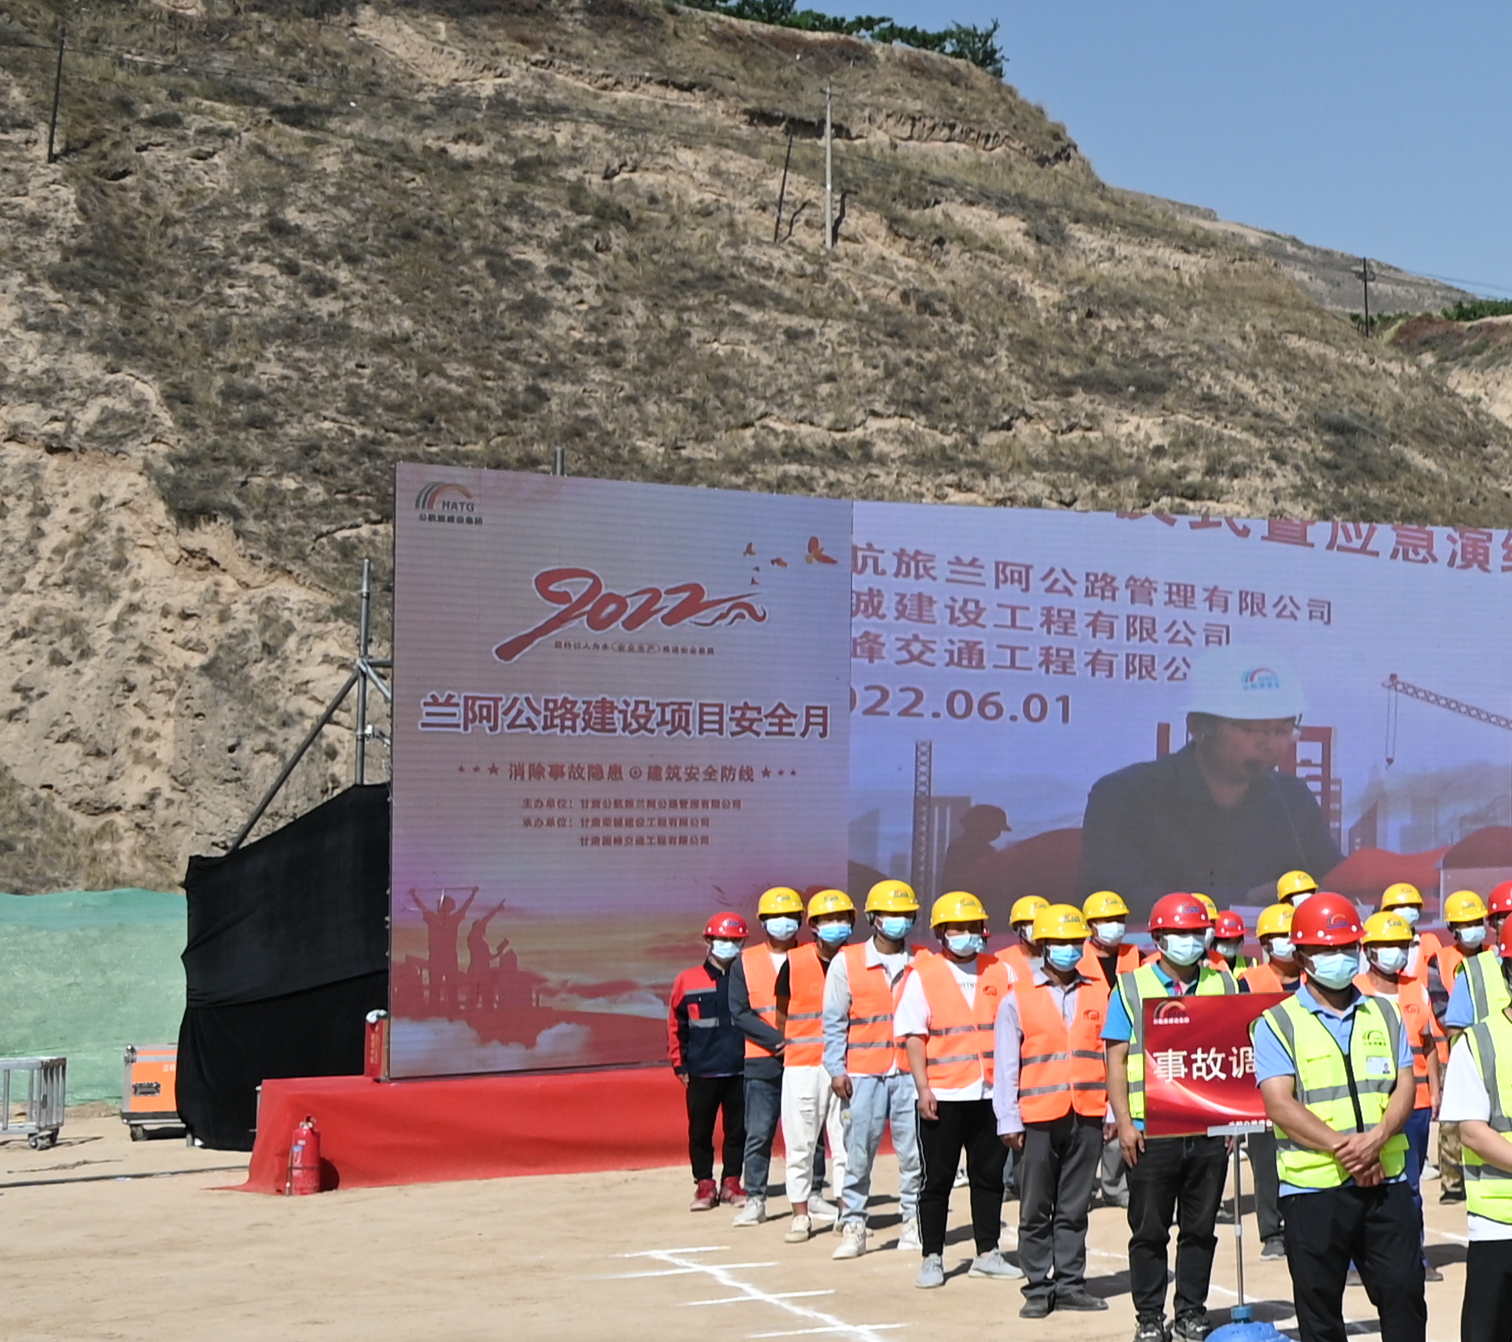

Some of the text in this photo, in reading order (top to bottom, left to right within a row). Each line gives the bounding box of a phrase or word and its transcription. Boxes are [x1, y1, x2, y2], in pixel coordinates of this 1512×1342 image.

[442, 500, 475, 512] HATG
[494, 567, 767, 663] 2022
[419, 693, 831, 740] 兰阿公路建设项目安全月
[850, 684, 1071, 724] 22.06.01
[508, 762, 755, 782] 消除事故隐患 建筑安全防线
[1152, 1046, 1257, 1083] 事故调
